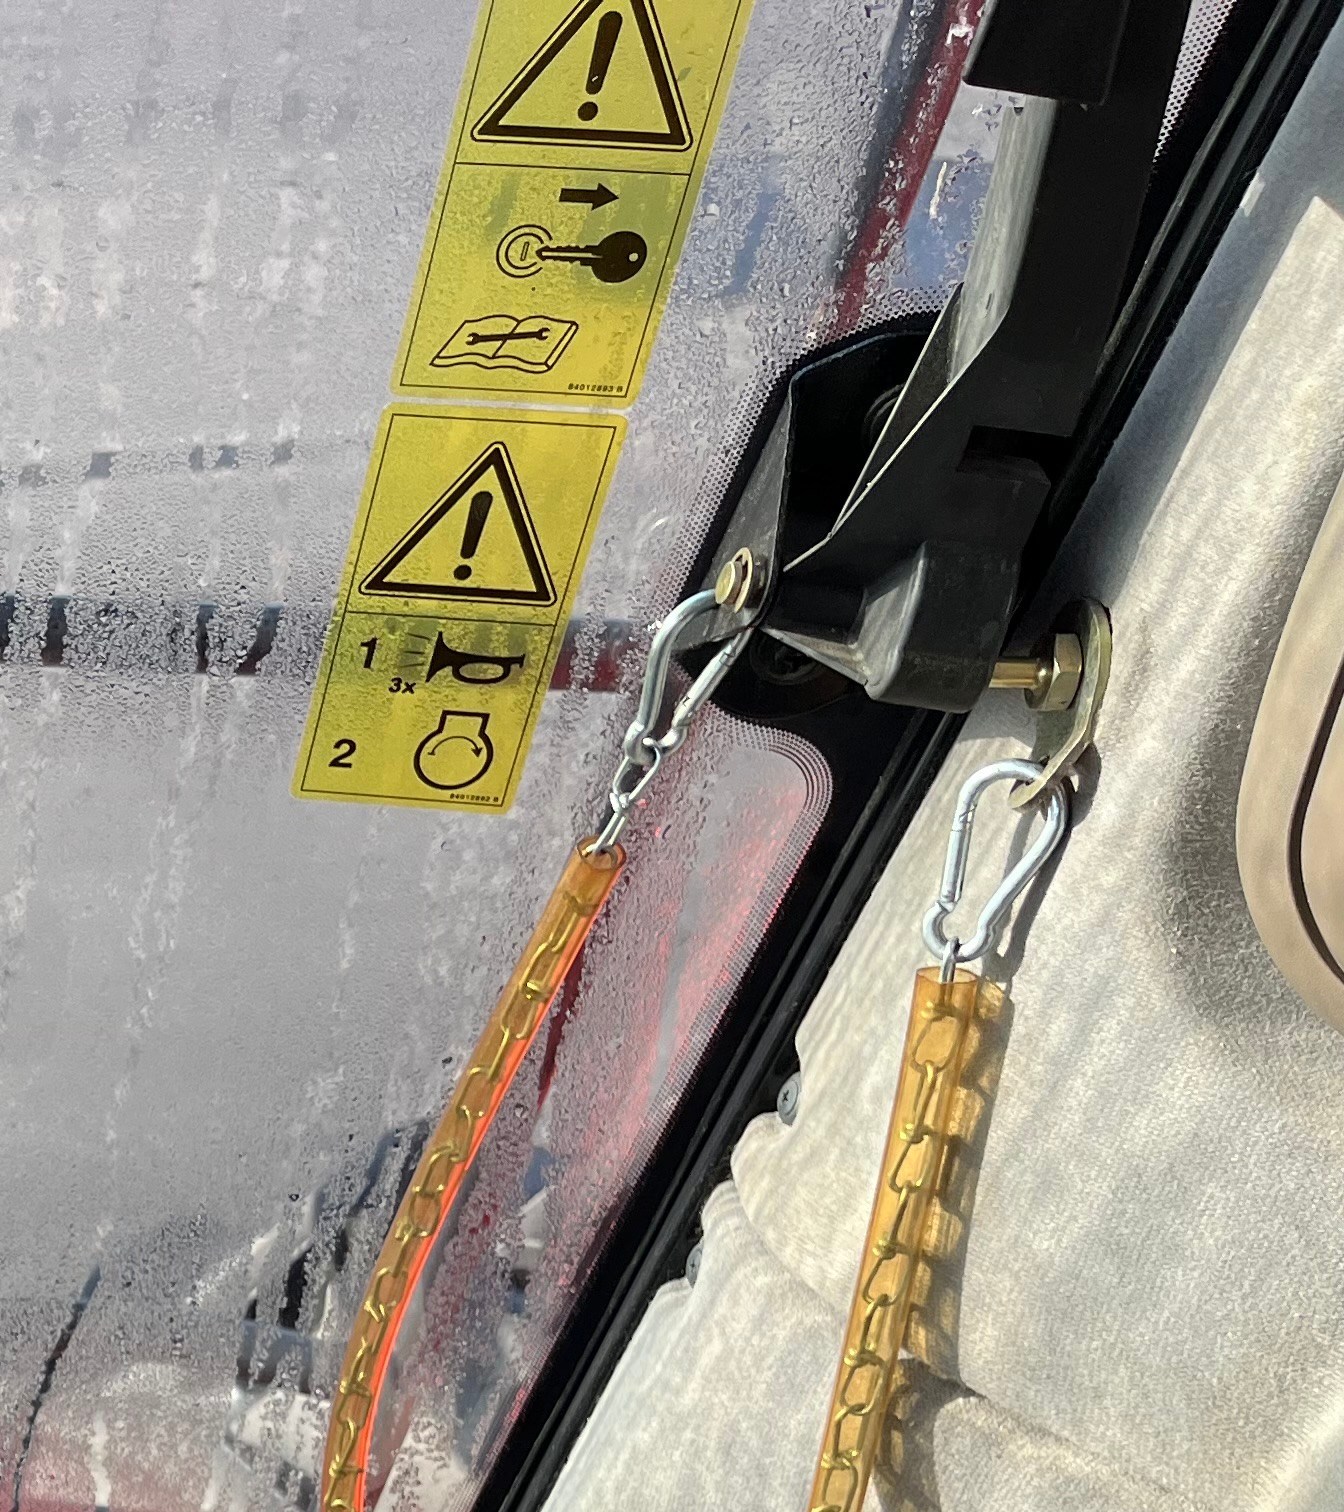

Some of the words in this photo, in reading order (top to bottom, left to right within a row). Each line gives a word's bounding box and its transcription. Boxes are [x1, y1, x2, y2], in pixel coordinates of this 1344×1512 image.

[359, 637, 379, 668] 1
[388, 676, 417, 695] 3x
[328, 738, 358, 769] 2
